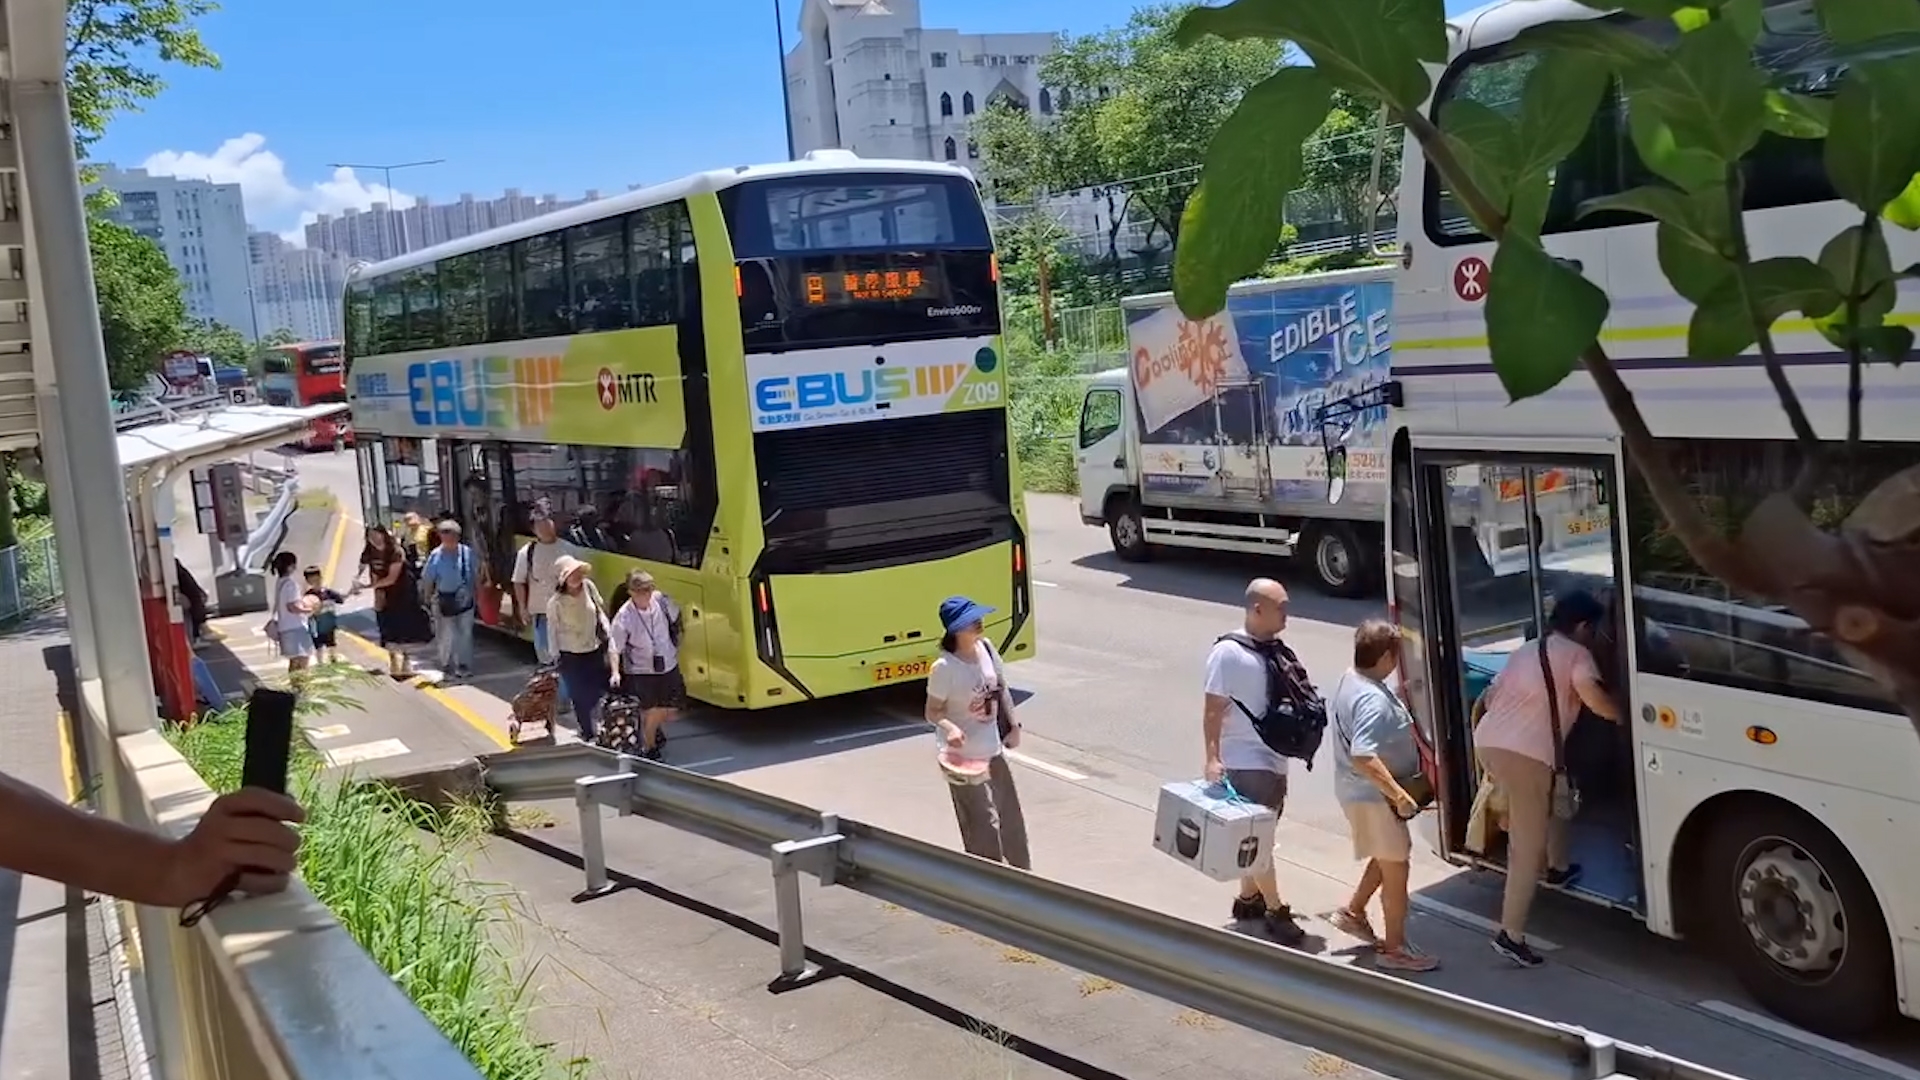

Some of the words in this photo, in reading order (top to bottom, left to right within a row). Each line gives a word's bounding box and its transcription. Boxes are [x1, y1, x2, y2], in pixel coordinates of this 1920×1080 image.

[1270, 290, 1359, 363] EDIBLE
[1330, 308, 1393, 374] ICE
[617, 374, 659, 403] MTR
[962, 381, 999, 405] Z09
[876, 667, 892, 680] ZZ
[898, 661, 927, 676] 5997
